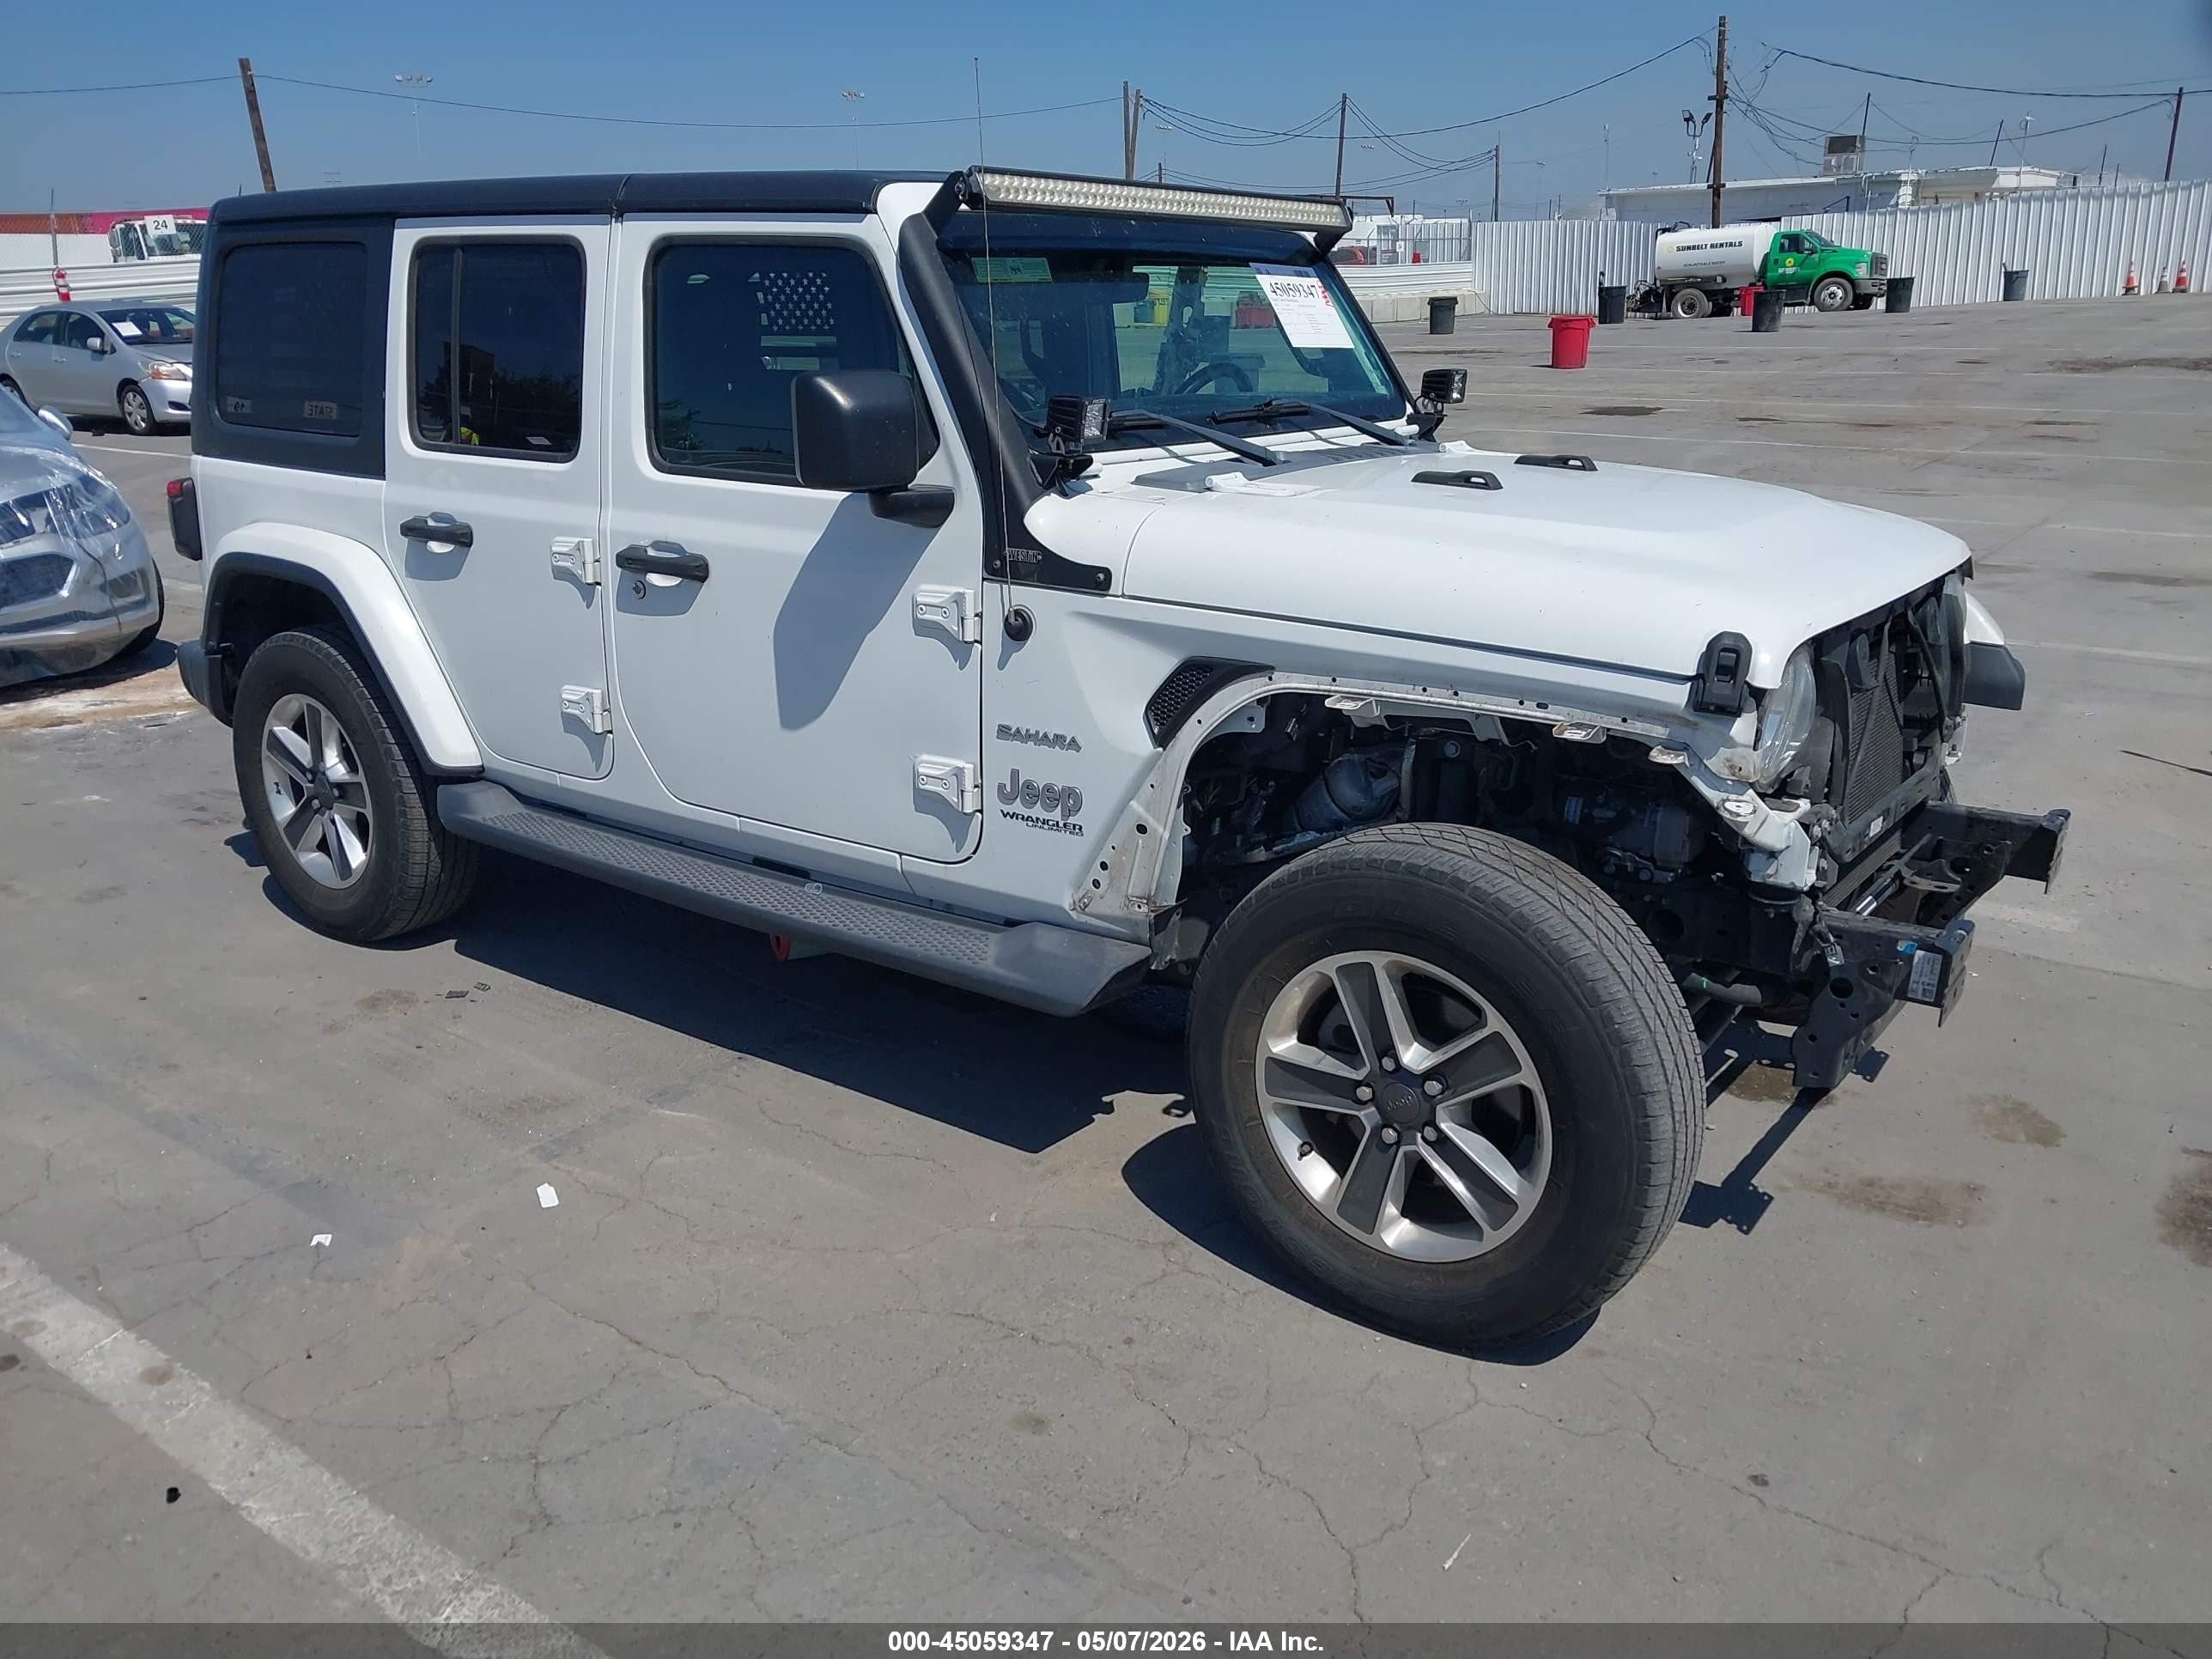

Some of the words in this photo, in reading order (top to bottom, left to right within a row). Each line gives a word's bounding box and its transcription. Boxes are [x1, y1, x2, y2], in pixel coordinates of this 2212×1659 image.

[153, 220, 167, 230] 24
[1710, 240, 1743, 249] RENTALS
[1269, 281, 1320, 300] 45059347
[996, 723, 1082, 753] SAHARA
[996, 768, 1083, 822] Jeep
[1000, 809, 1083, 832] WRANGLER
[1025, 822, 1085, 837] UNLIMITED
